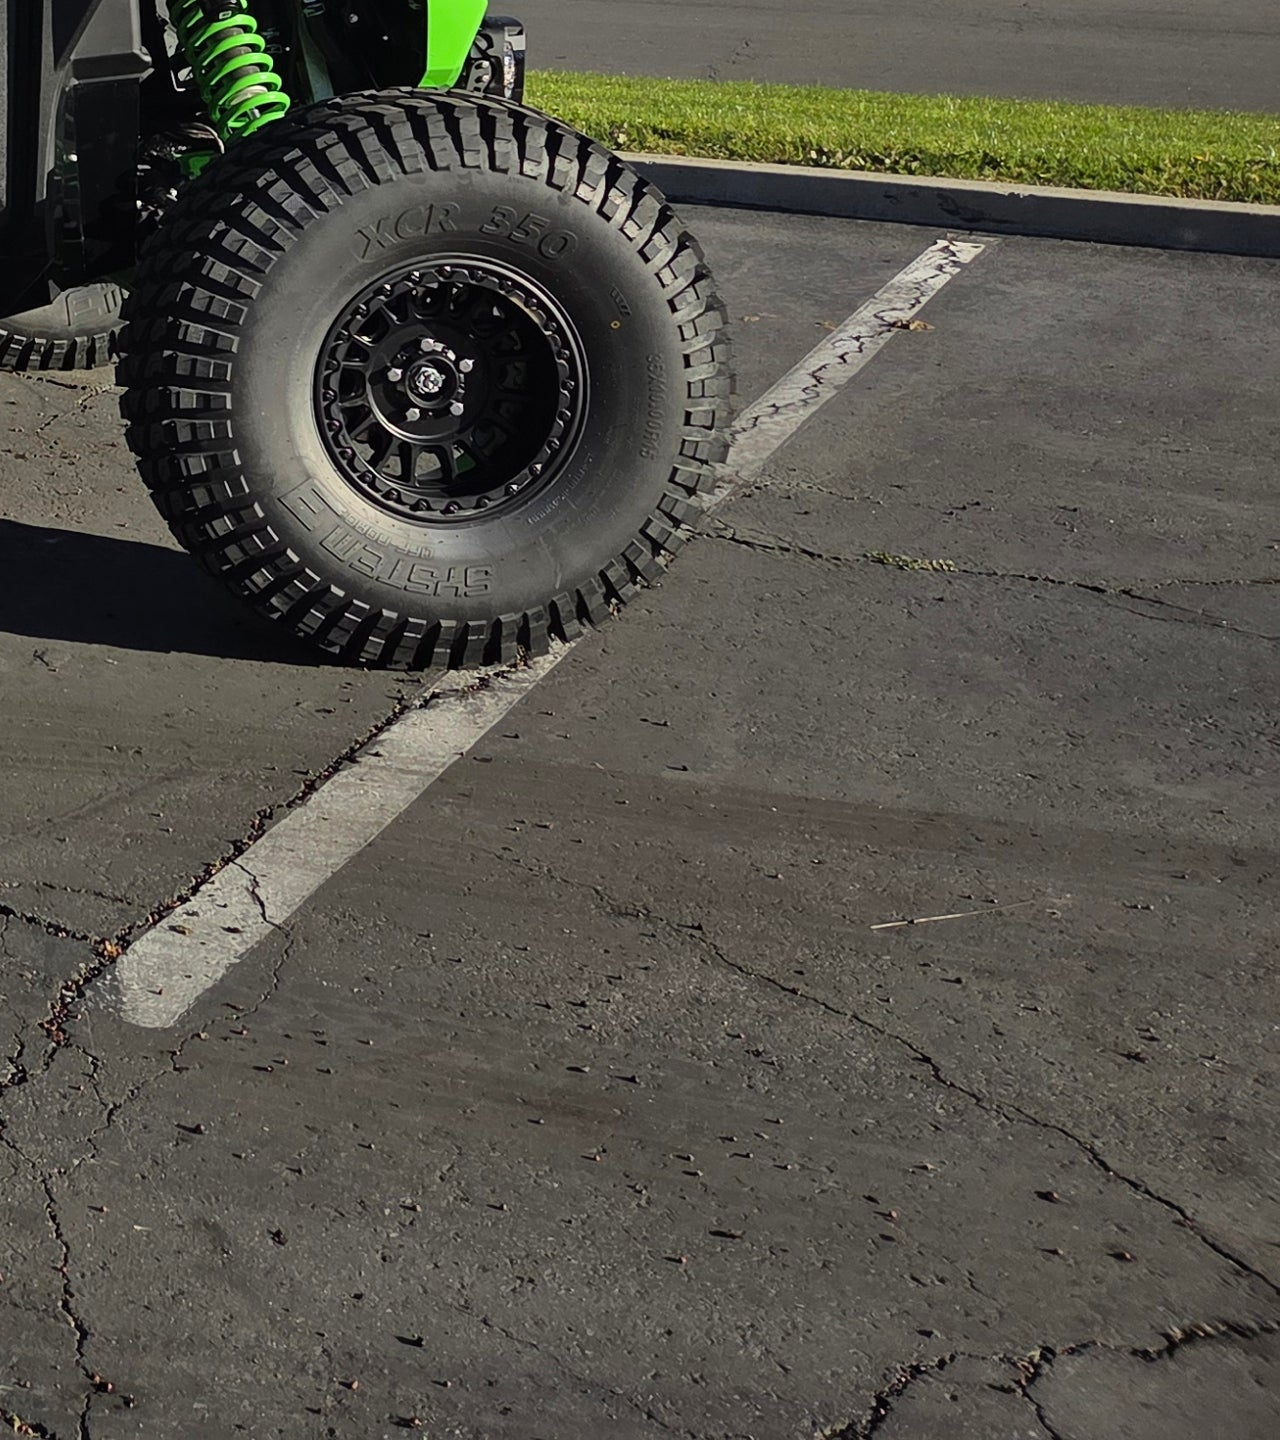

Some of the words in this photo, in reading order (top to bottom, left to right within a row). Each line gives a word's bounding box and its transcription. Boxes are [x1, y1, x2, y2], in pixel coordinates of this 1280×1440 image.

[354, 201, 461, 261] XCR
[479, 205, 578, 260] 350
[319, 524, 493, 598] SYSTEM
